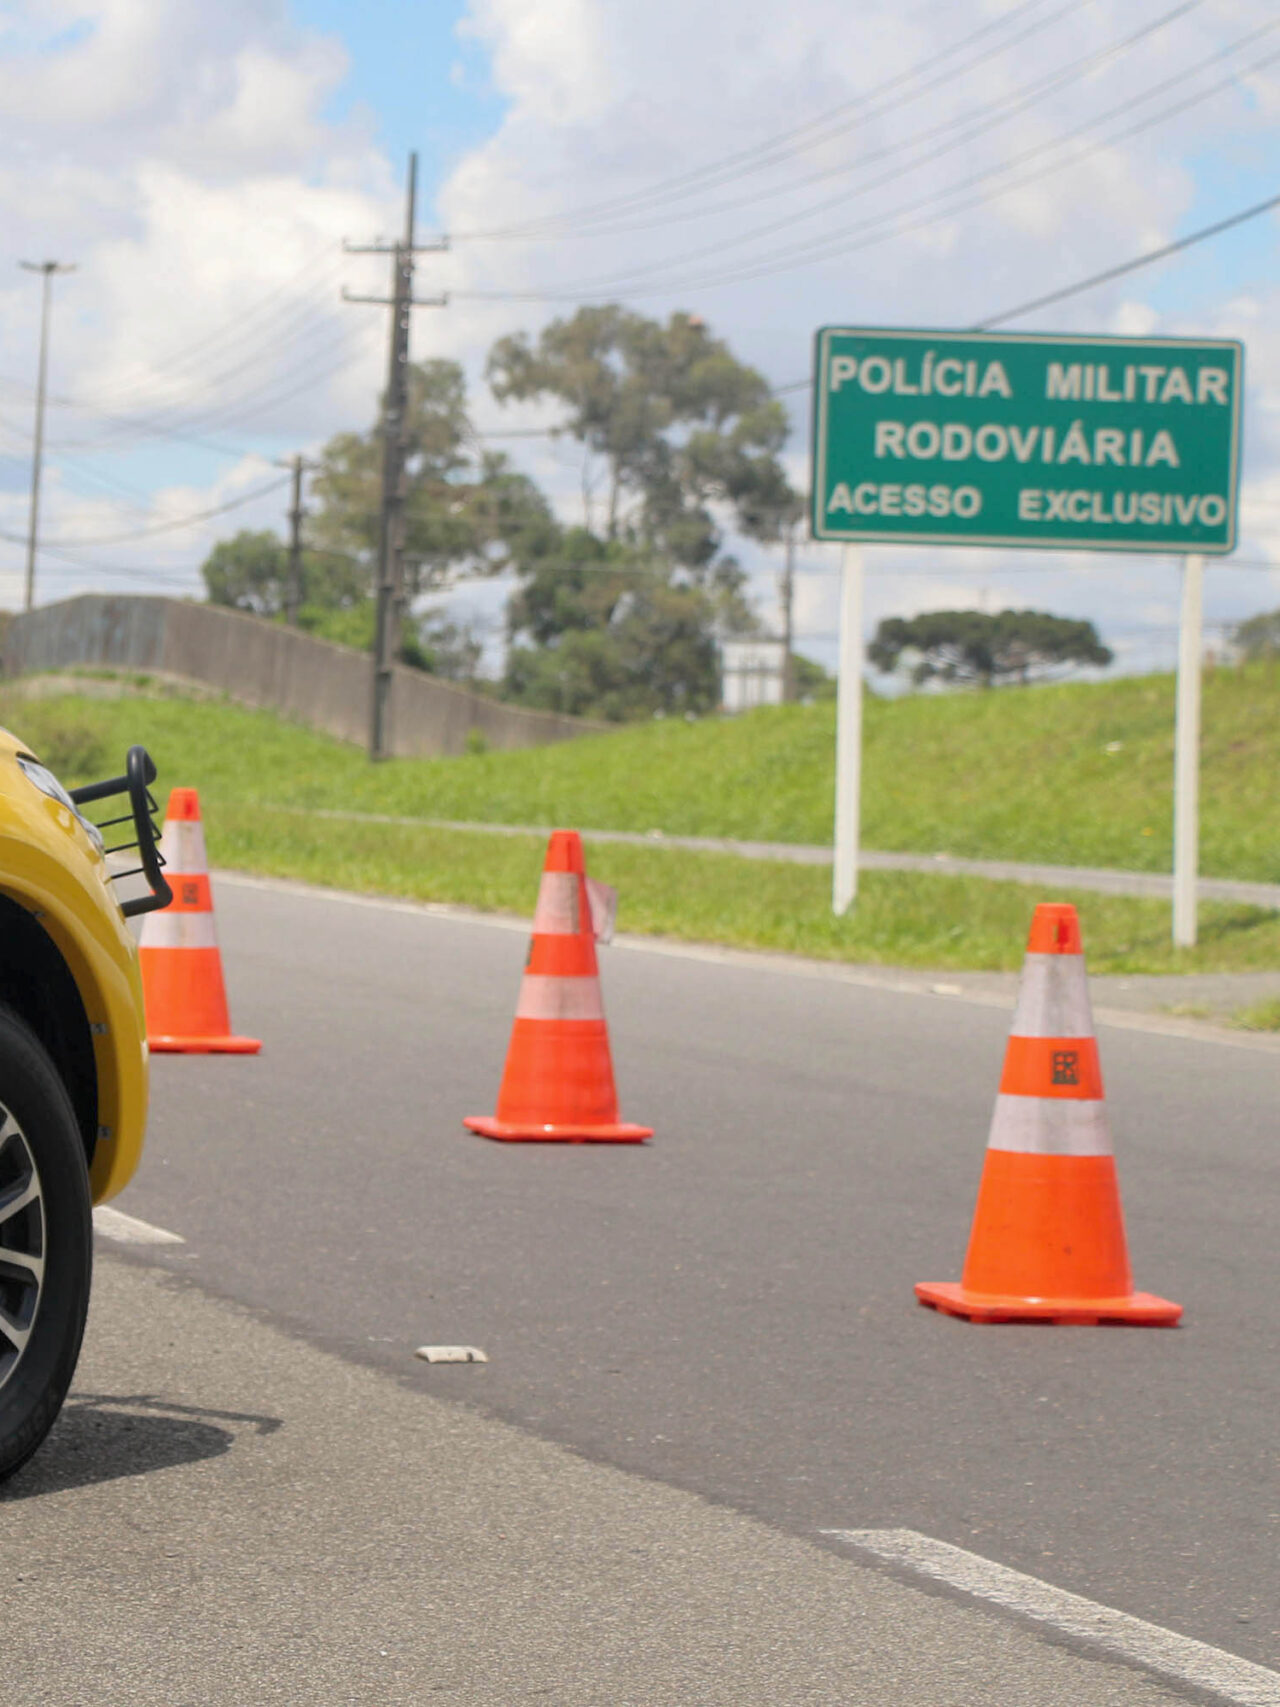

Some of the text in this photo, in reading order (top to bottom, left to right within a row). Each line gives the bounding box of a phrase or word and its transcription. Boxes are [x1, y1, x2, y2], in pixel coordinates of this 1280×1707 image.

[829, 351, 1228, 405] POLÍCIA MILITAR
[874, 420, 1180, 468] RODOVIÁRIA
[827, 482, 1226, 526] ACESSO EXCLUSIVO
